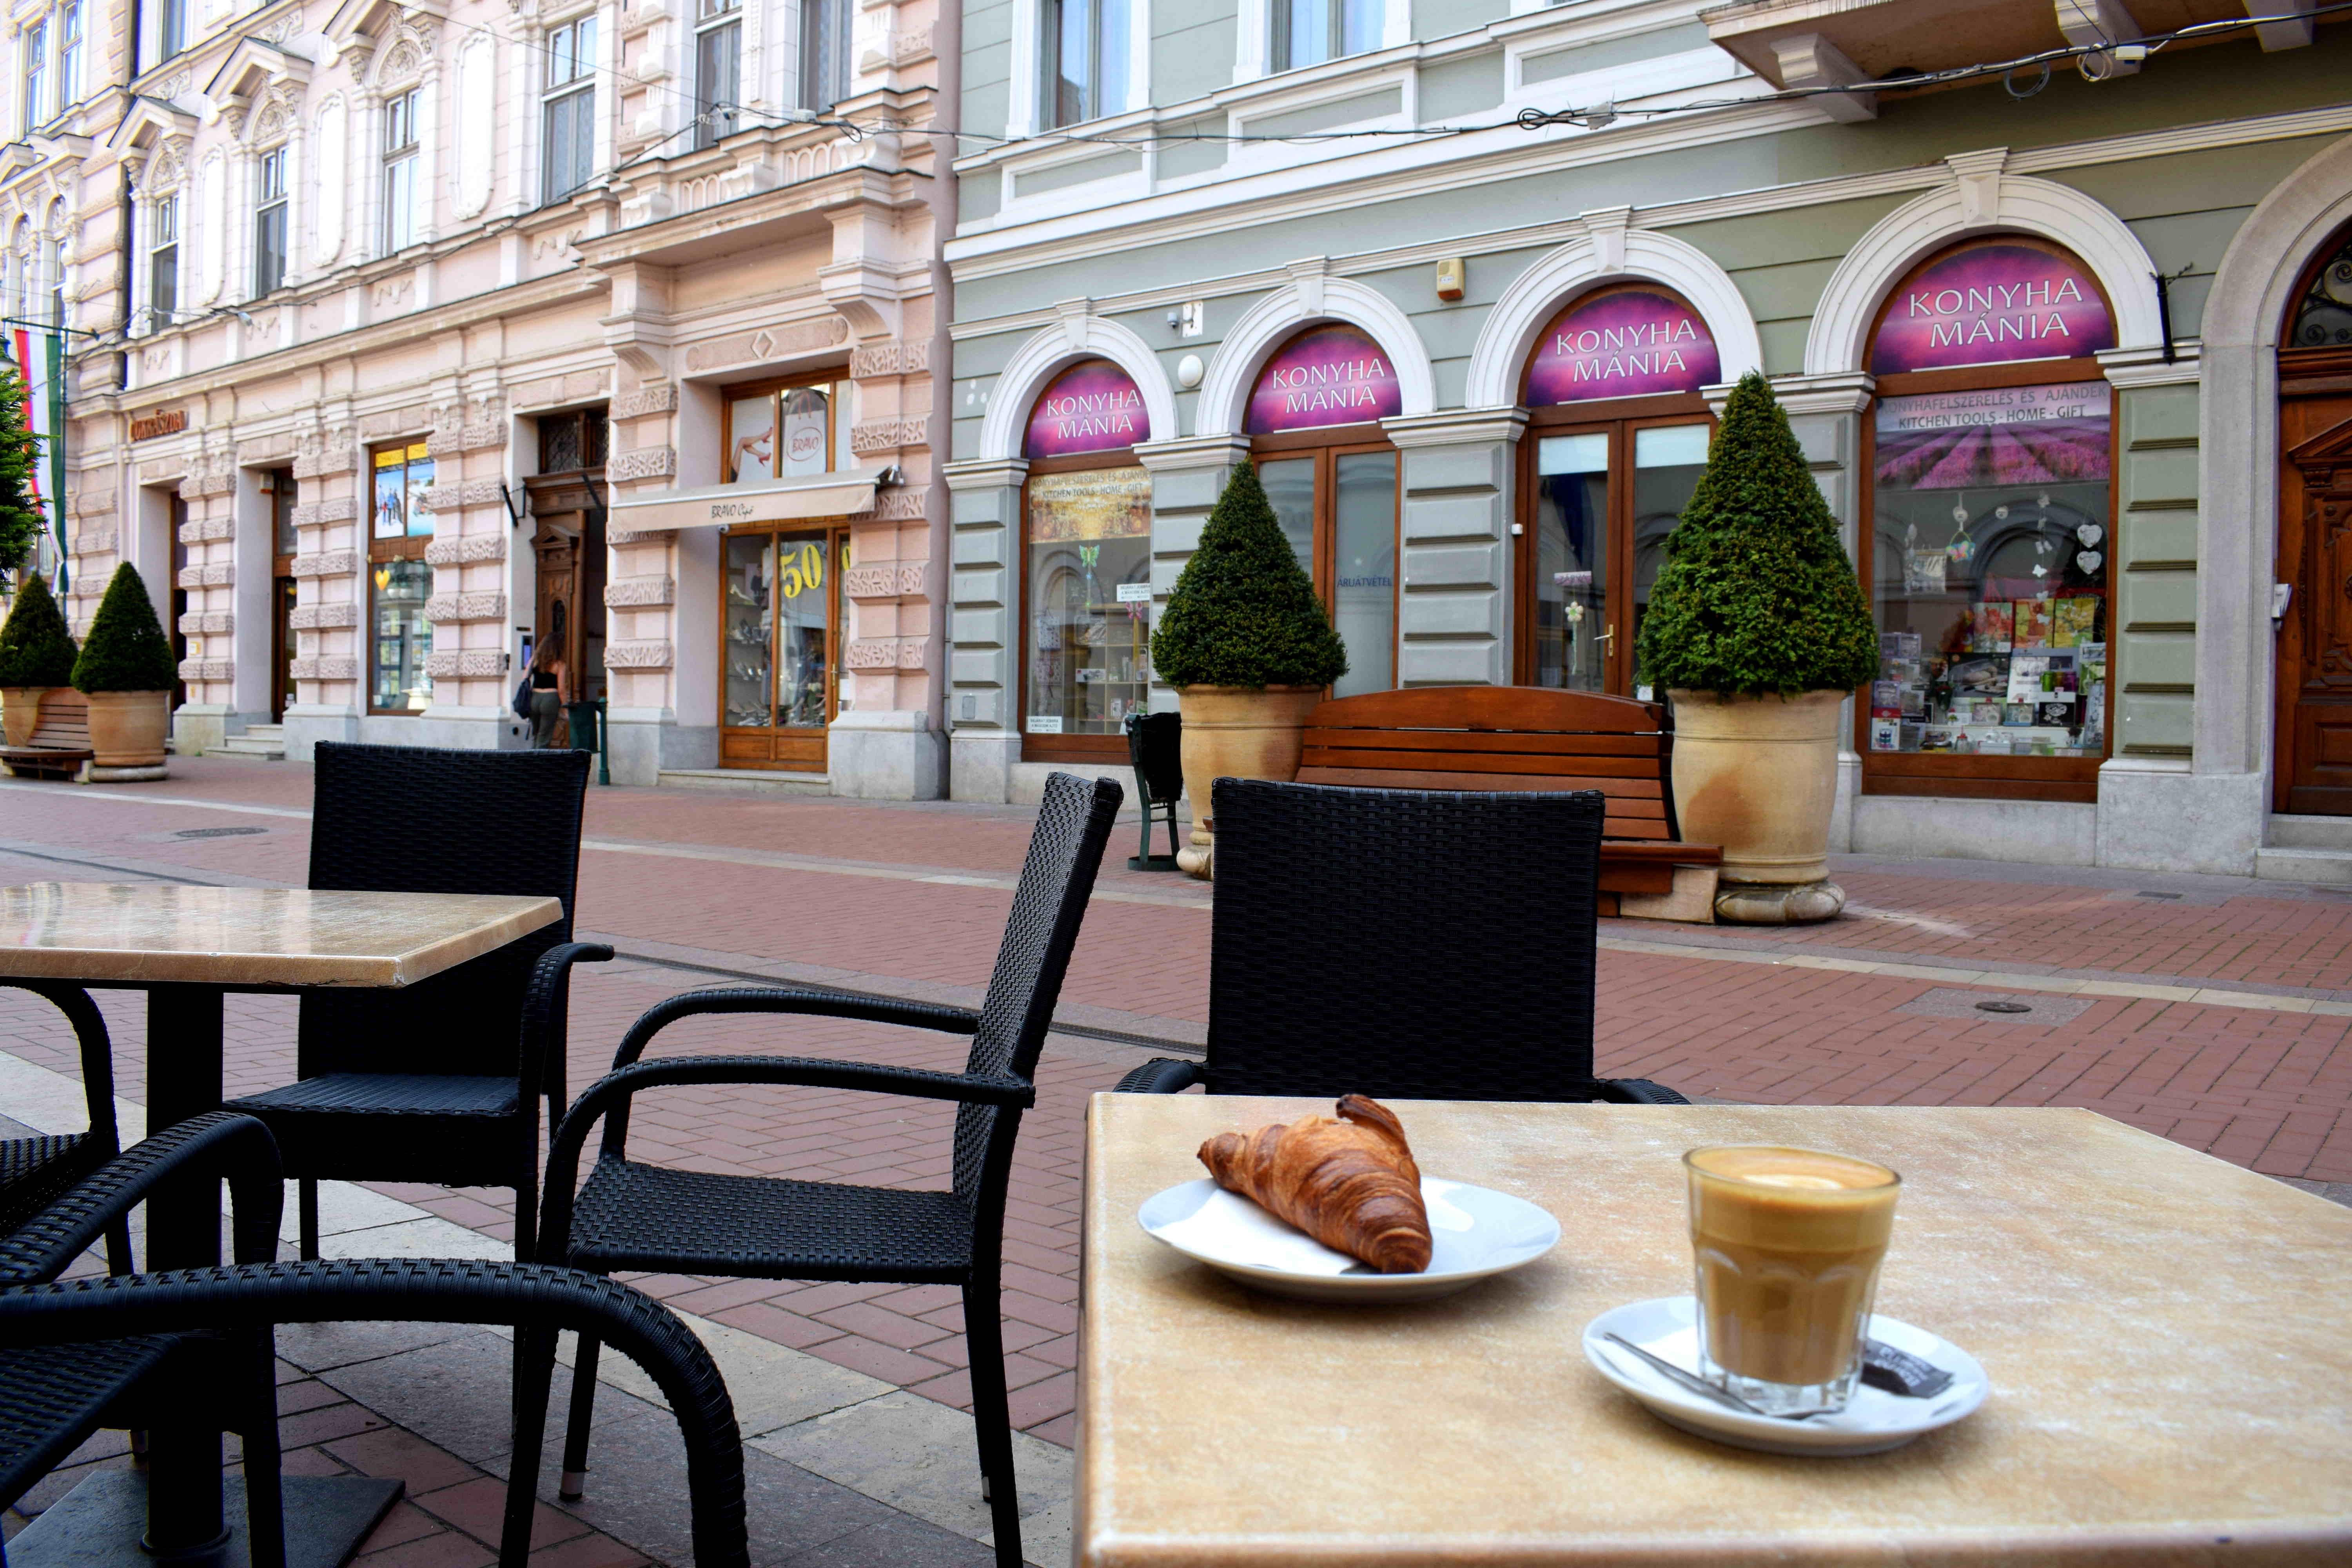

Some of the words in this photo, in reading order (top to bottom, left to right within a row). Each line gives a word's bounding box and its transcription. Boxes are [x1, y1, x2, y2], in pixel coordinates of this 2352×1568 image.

[1909, 278, 2083, 318] KONYHA
[1557, 319, 1697, 356] KONYHA
[1930, 311, 2070, 348] MÁNIA
[1273, 358, 1385, 389] KONYHA
[1573, 349, 1686, 382] MÁNIA
[1047, 389, 1140, 417] KONYHA
[1286, 385, 1376, 414] MÁNIA
[1882, 390, 2013, 413] KONYHAFELSZERELÉS
[2020, 388, 2035, 404] ÉS
[1058, 414, 1133, 439] MÁNIA
[1899, 415, 1950, 429] KITCHEN
[1955, 411, 1996, 425] TOOLS
[2007, 408, 2046, 421] HOME
[2057, 405, 2086, 418] GIFT
[792, 437, 819, 452] BRAVO
[1043, 488, 1071, 499] KITCHEN
[1073, 486, 1095, 496] TOOLS
[1101, 484, 1122, 494] HOME
[1127, 483, 1143, 492] GIFT
[712, 504, 736, 518] BRAVO
[780, 544, 822, 598] 50
[1337, 574, 1392, 587] ÁRUÁTVÉTEL
